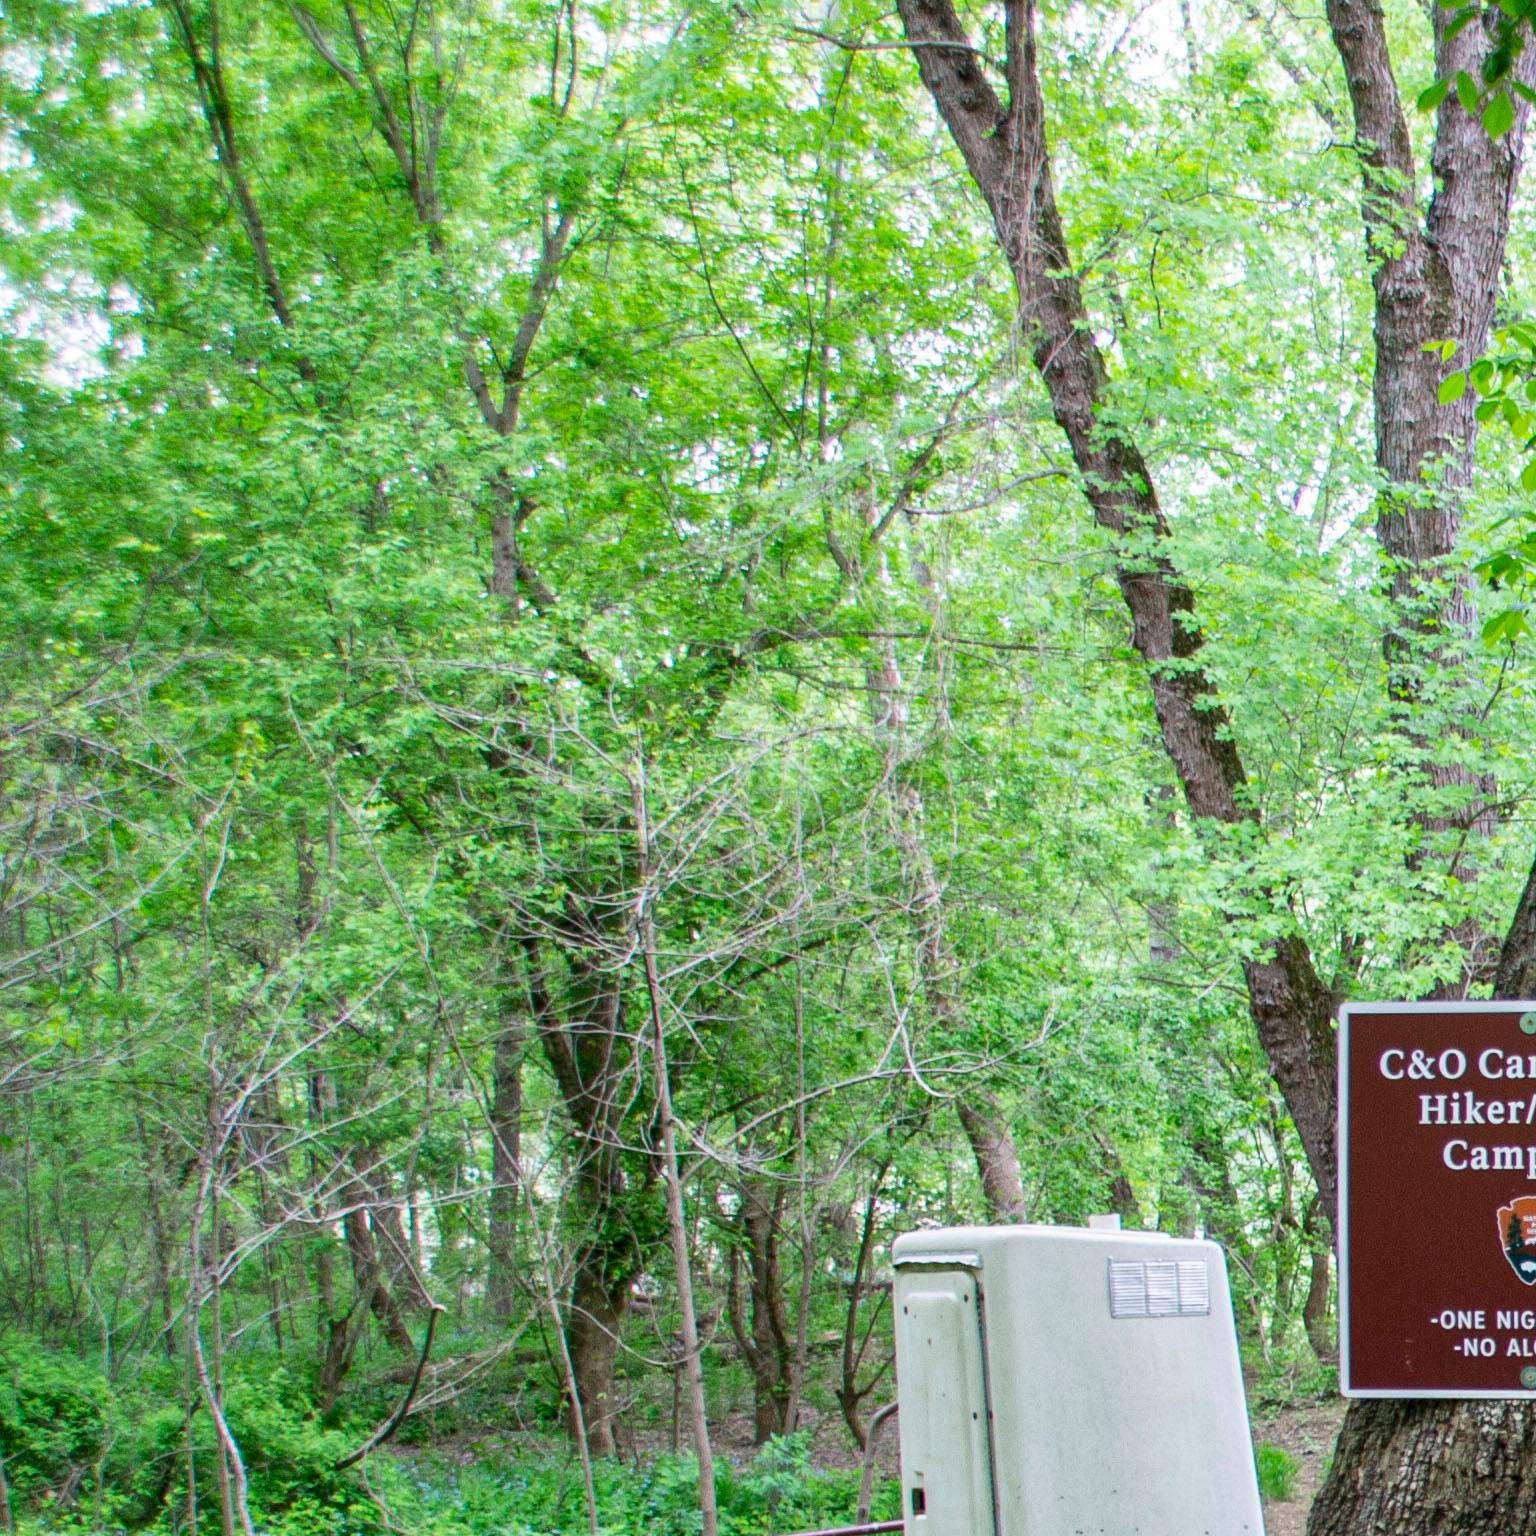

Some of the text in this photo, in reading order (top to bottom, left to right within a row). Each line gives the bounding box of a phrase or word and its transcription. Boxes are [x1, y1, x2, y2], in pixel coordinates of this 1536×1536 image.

[1380, 1049, 1466, 1079] C&O
[1431, 1310, 1485, 1329] -ONE
[1454, 1338, 1496, 1357] -NO
